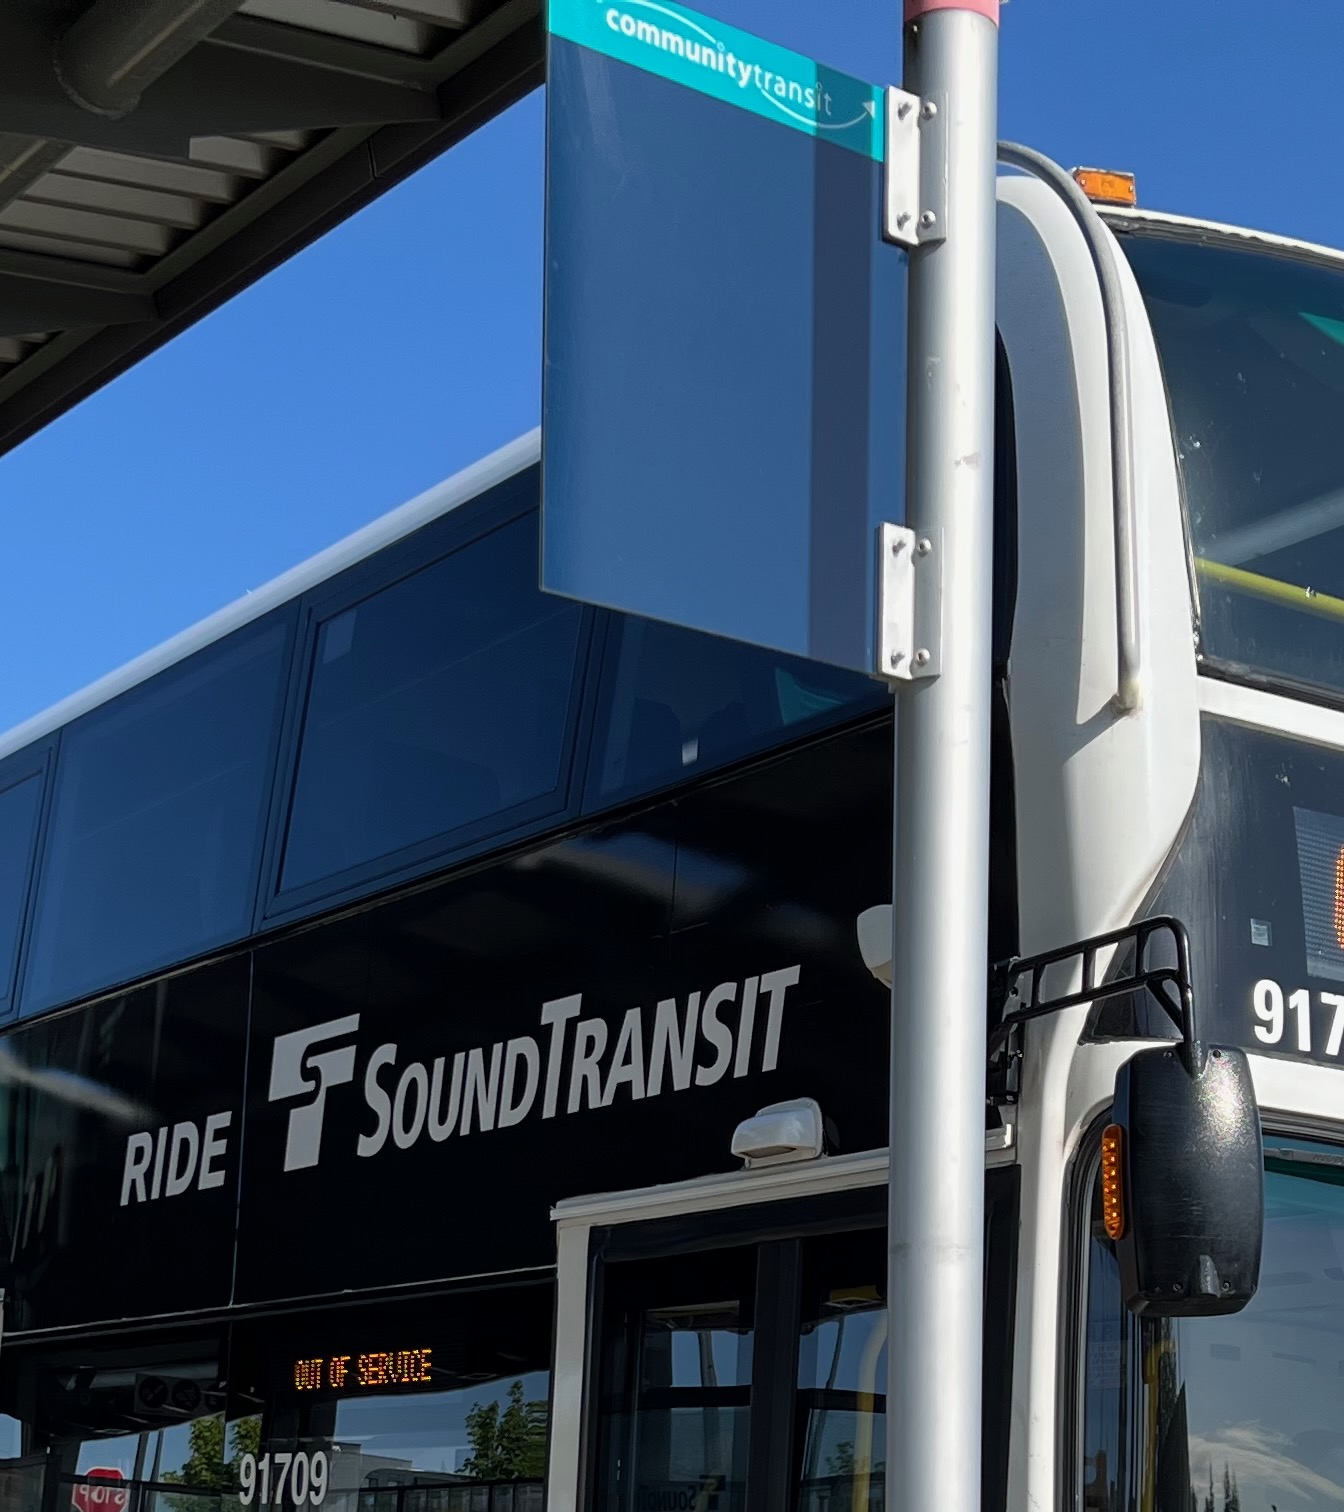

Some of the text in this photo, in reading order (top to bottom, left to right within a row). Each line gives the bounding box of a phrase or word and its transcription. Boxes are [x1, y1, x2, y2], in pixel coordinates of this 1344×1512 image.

[120, 1110, 232, 1206] RIDE
[294, 1348, 433, 1391] OUT OF SERVICE
[239, 1450, 329, 1506] 91709
